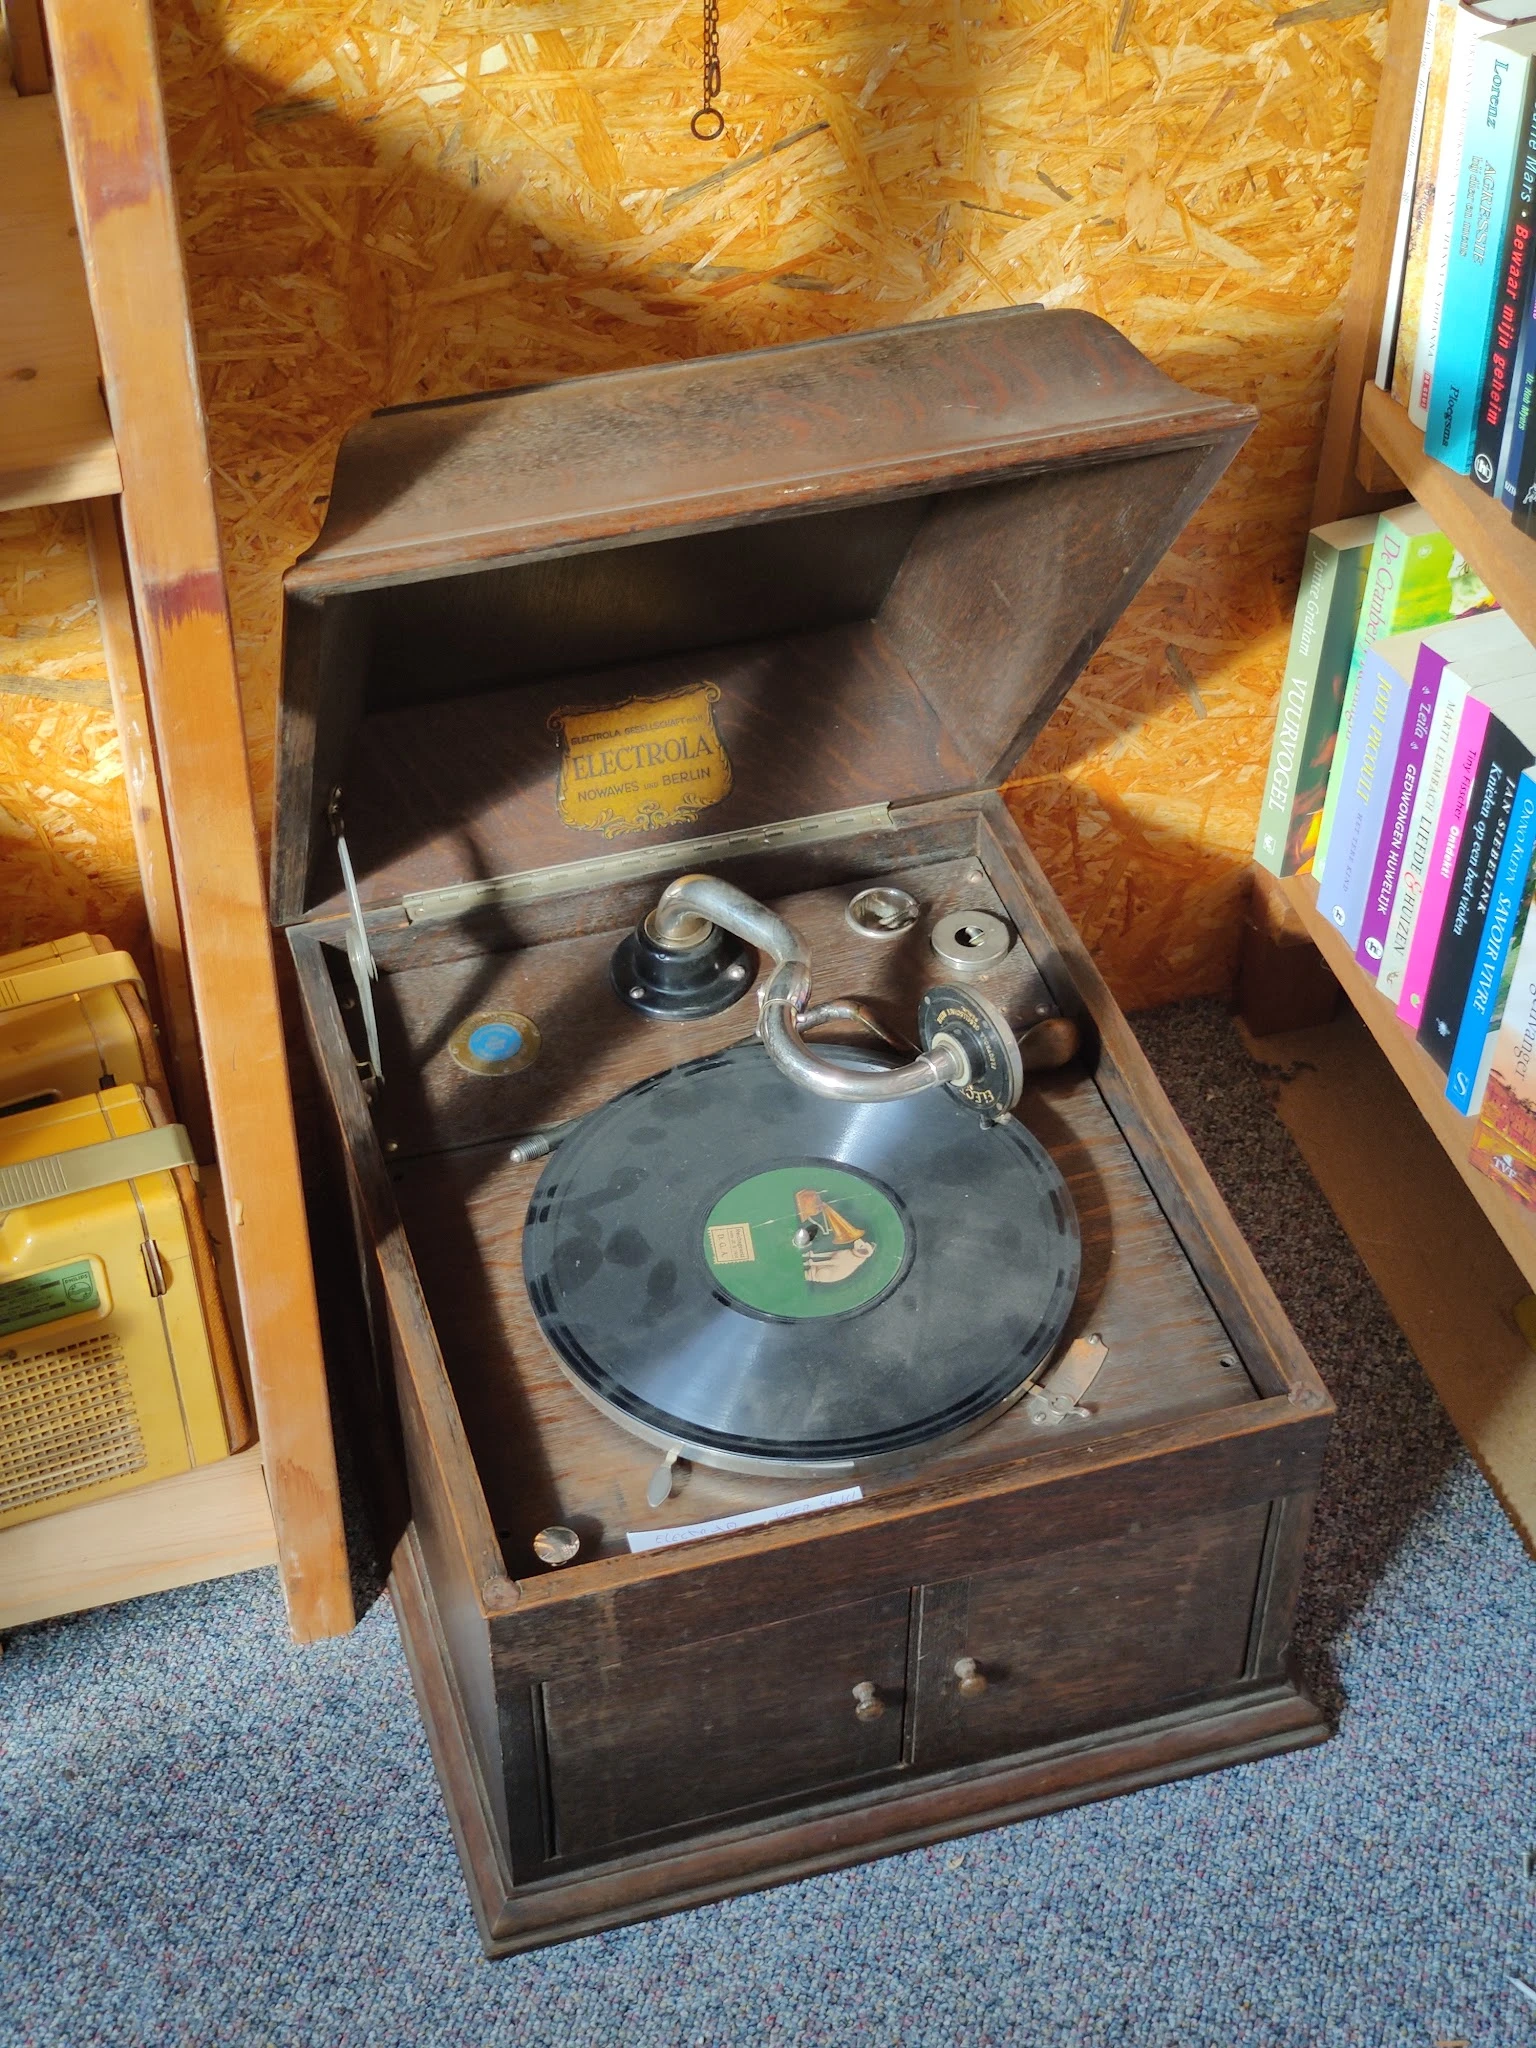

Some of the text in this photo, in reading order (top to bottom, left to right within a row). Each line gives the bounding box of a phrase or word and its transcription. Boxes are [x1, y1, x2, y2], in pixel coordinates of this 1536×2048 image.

[1486, 58, 1509, 129] Lorenz
[1521, 155, 1536, 203] Mars
[1472, 160, 1497, 266] AGRESSIE
[1506, 224, 1529, 300] Bewaar
[1497, 304, 1516, 350] mijn
[1441, 384, 1459, 447] Ploegsma
[1486, 353, 1507, 426] geheim
[1383, 534, 1401, 564] De
[1300, 551, 1328, 657] Janice Graham
[570, 729, 621, 746] ELECTROLA
[624, 717, 686, 735] GESELLSCHAFT
[1268, 677, 1308, 813] VUURVOGEL
[1356, 672, 1393, 807] JODI PICOULT
[1439, 700, 1456, 747] MARTI
[571, 735, 713, 781] ELECTROLA
[577, 781, 640, 803] NOWAWES
[661, 767, 711, 786] BERLIN
[1425, 746, 1448, 813] LEIMBACH
[1464, 750, 1477, 774] Tiny
[1376, 763, 1417, 916] GEDWONGEN HUWELIJK
[1414, 815, 1433, 876] LIEFDE
[1453, 761, 1503, 936] Knielen op een bed violen
[1477, 776, 1516, 915] JAN SIEBELINK
[1395, 890, 1418, 957] HUIZEN
[1485, 891, 1512, 961] SAVOIR
[1472, 965, 1497, 1016] VIVRE
[64, 1273, 89, 1285] PHILIPS
